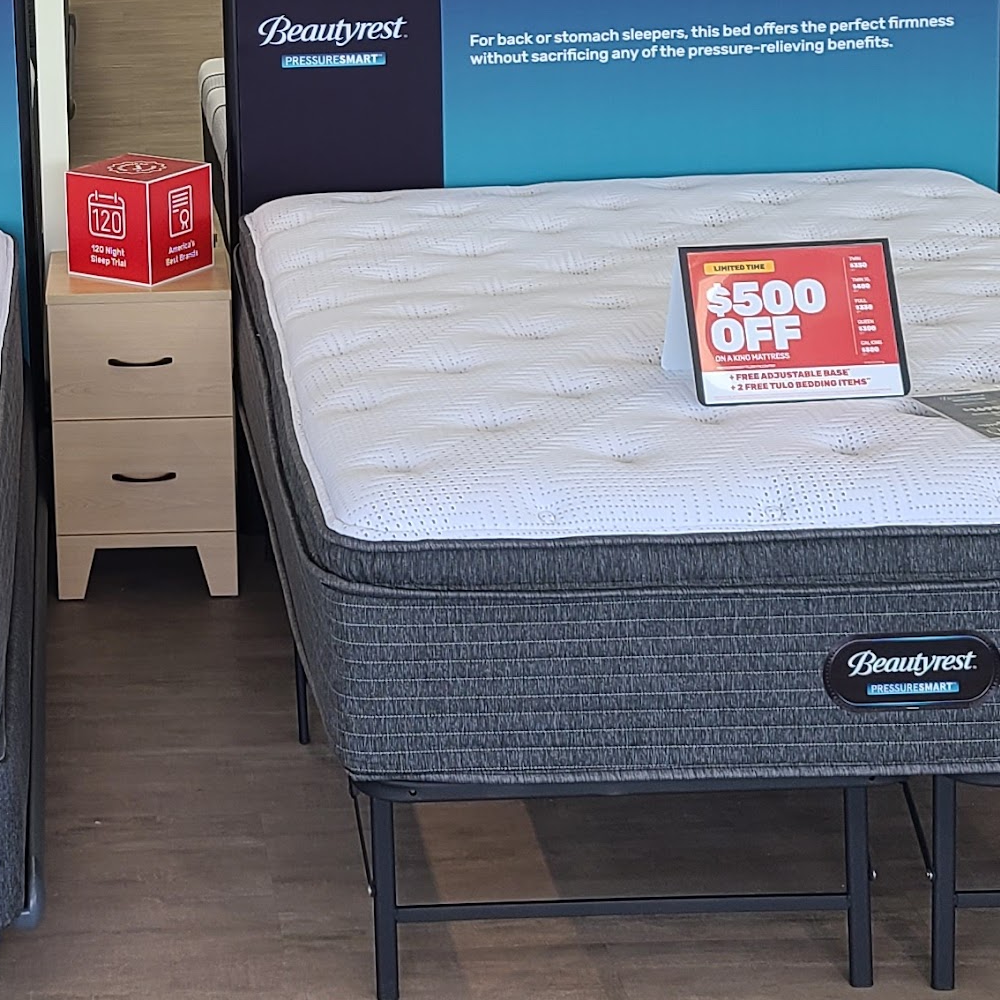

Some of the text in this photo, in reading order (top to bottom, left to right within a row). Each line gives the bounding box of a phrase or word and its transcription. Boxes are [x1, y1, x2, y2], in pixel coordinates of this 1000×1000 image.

[258, 14, 408, 46] Beautyrest
[470, 16, 954, 47] For back or stomach sleepers, this bed offers the perfect firmness
[470, 36, 894, 65] without sacrificing any of the pressure-relieving benefits.
[92, 208, 122, 234] 120
[90, 255, 127, 268] Sleep Trial
[91, 244, 125, 257] 120 Night
[706, 278, 826, 318] $500
[711, 315, 802, 354] OFF
[752, 352, 790, 361] MATTRESS
[761, 370, 822, 380] ADJUSTABLE
[796, 380, 837, 388] BEDDING
[847, 650, 978, 677] Beautyrest
[871, 682, 954, 693] PRESSURESMART
